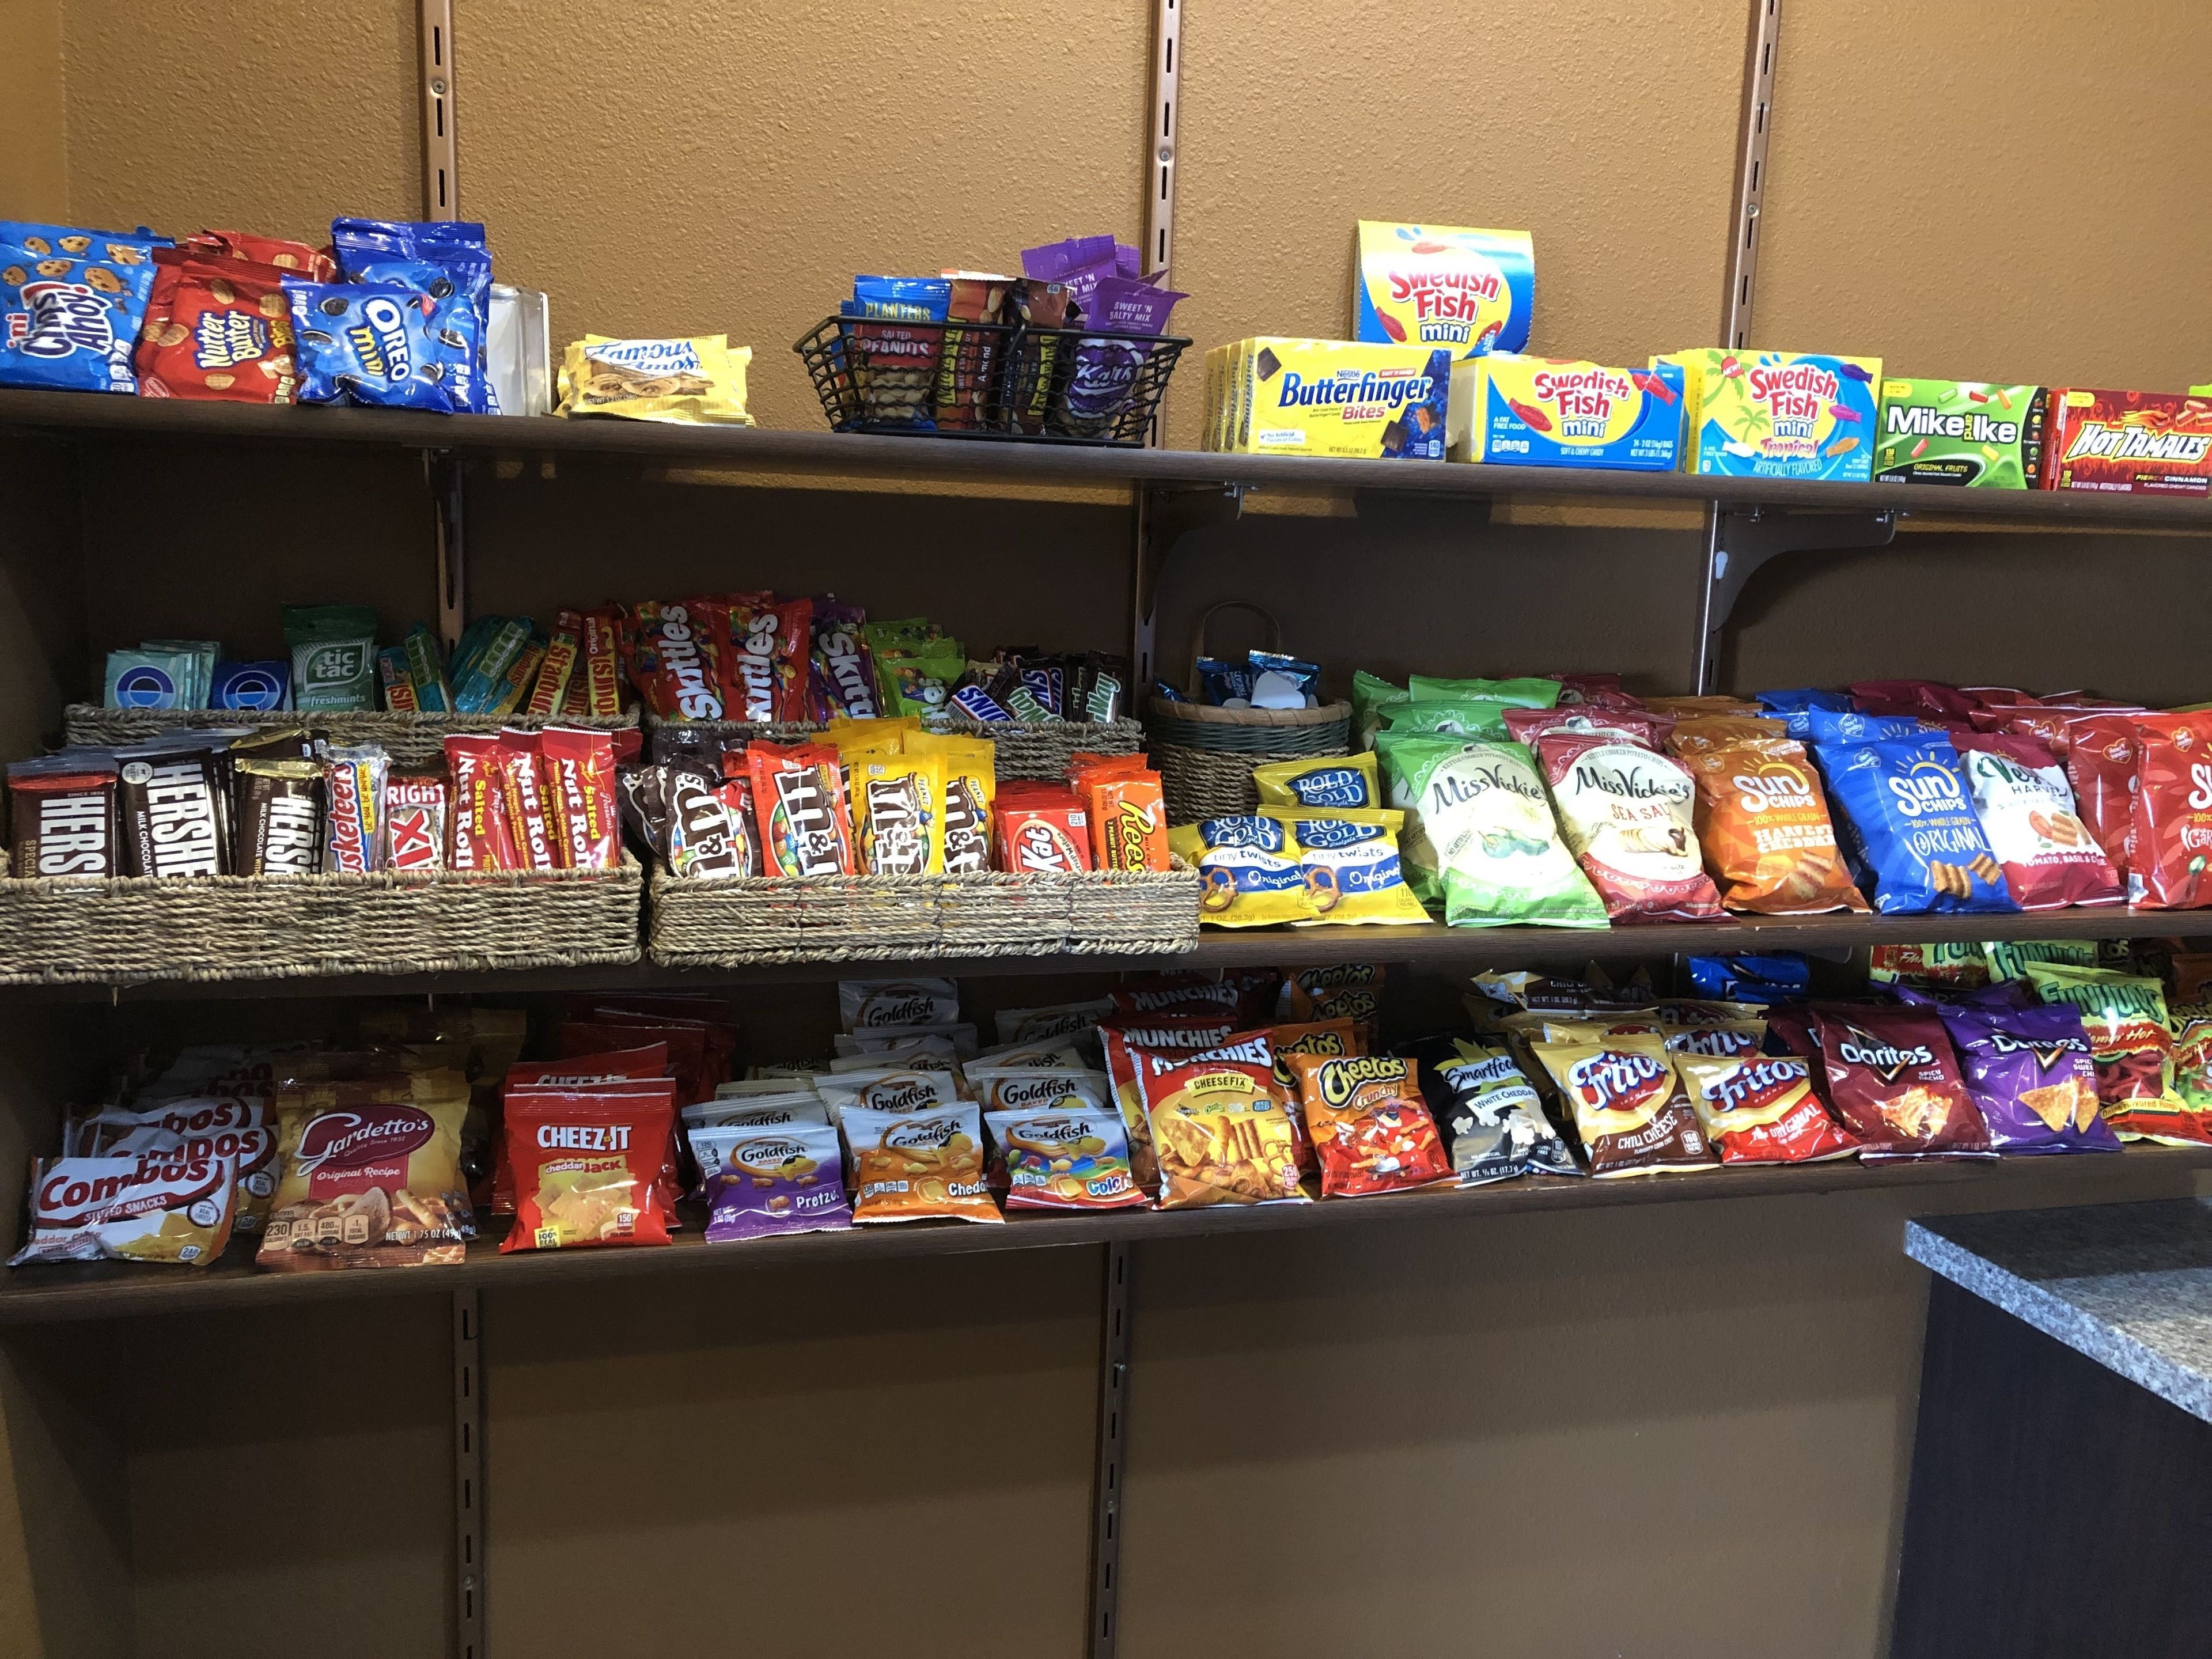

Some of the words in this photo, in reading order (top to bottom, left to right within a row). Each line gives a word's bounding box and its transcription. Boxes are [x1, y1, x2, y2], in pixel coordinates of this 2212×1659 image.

[1109, 312, 1132, 321] SALTY
[1135, 313, 1150, 322] MIX
[1114, 302, 1140, 312] SWEET
[1414, 289, 1476, 321] Fish
[199, 311, 234, 368] Nutter
[225, 310, 262, 362] Butter
[365, 298, 411, 381] OREO
[1419, 323, 1471, 344] mini
[349, 327, 384, 376] mini
[1278, 372, 1431, 408] Butterfinger
[1535, 372, 1630, 400] Swedish
[1749, 367, 1838, 400] Swedish
[1342, 406, 1385, 420] Bites
[1557, 390, 1611, 418] Fish
[1769, 391, 1819, 419] Fish
[1562, 421, 1607, 437] mini
[1774, 421, 1813, 438] mini
[1887, 406, 1965, 436] Mike
[1973, 415, 2017, 442] Ike
[1760, 438, 1820, 462] Tropical
[2066, 423, 2124, 460] HOT
[2112, 425, 2211, 461] TAMALES
[1752, 461, 1791, 477] ARTIFICIALLY
[1791, 459, 1823, 475] FLAVORED
[2164, 476, 2208, 484] CINNAMON
[588, 617, 597, 654] Original
[323, 649, 355, 665] tic
[657, 605, 722, 720] Skittles
[315, 662, 354, 677] tac
[310, 692, 366, 707] freshmints
[458, 756, 476, 805] Nut
[561, 758, 583, 808] Nut
[918, 779, 929, 805] PEANUT
[969, 780, 984, 804] PEANUT
[1297, 771, 1354, 793] ROLD
[1434, 776, 1490, 815] Miss
[1476, 764, 1547, 806] Vickie's
[1576, 767, 1623, 796] Miss
[387, 785, 444, 805] RIGHT
[1302, 784, 1365, 805] GOLD
[1733, 775, 1810, 812] Sun
[1768, 794, 1816, 808] CHIPS
[1888, 776, 1960, 816] Sun
[1923, 797, 1967, 813] CHIPS
[137, 810, 145, 830] MILK
[260, 802, 268, 819] MILK
[475, 779, 486, 837] Salted
[539, 784, 557, 840] Salted
[583, 785, 601, 840] Salted
[1611, 804, 1637, 821] SEA
[1754, 815, 1774, 825] 100%
[1911, 819, 1929, 828] 100%
[256, 817, 265, 857] CHOCOLATE
[456, 810, 475, 868] Roll
[1107, 826, 1116, 848] PEANUT
[1214, 824, 1277, 850] GOLD
[1913, 826, 1993, 856] ORIGINAL
[1214, 850, 1237, 862] tiny
[1240, 849, 1282, 868] twists
[2064, 854, 2085, 863] BASIL
[1247, 870, 1303, 889] Original
[1130, 979, 1238, 1012] MUNCHIES
[869, 996, 934, 1027] Goldfish
[2126, 1027, 2156, 1041] Hot
[1840, 1043, 1933, 1066] Doritos
[1003, 1080, 1077, 1104] Goldfish
[1194, 1077, 1229, 1090] CHEESE
[1229, 1076, 1246, 1088] FIX
[1319, 1058, 1407, 1106] Cheetos
[1700, 1060, 1808, 1112] Fritos
[872, 1084, 937, 1111] Goldfish
[1353, 1083, 1398, 1110] Crunchy
[1474, 1095, 1502, 1109] WHITE
[892, 1120, 962, 1147] Goldfish
[1018, 1123, 1092, 1140] Goldfish
[1643, 1109, 1678, 1143] CHEESE
[1683, 1132, 1699, 1143] 160
[294, 1113, 429, 1177] Gardetto's
[741, 1144, 806, 1162] Goldfish
[317, 1168, 362, 1181] Original
[364, 1167, 400, 1179] Recipe
[546, 1161, 584, 1174] cheddar
[1283, 1166, 1297, 1177] 250
[39, 1160, 209, 1211] Combos
[125, 1195, 168, 1213] SNACKS
[267, 1224, 287, 1236] 230
[619, 1214, 631, 1222] 150
[385, 1232, 397, 1241] NET
[430, 1230, 440, 1238] OZ
